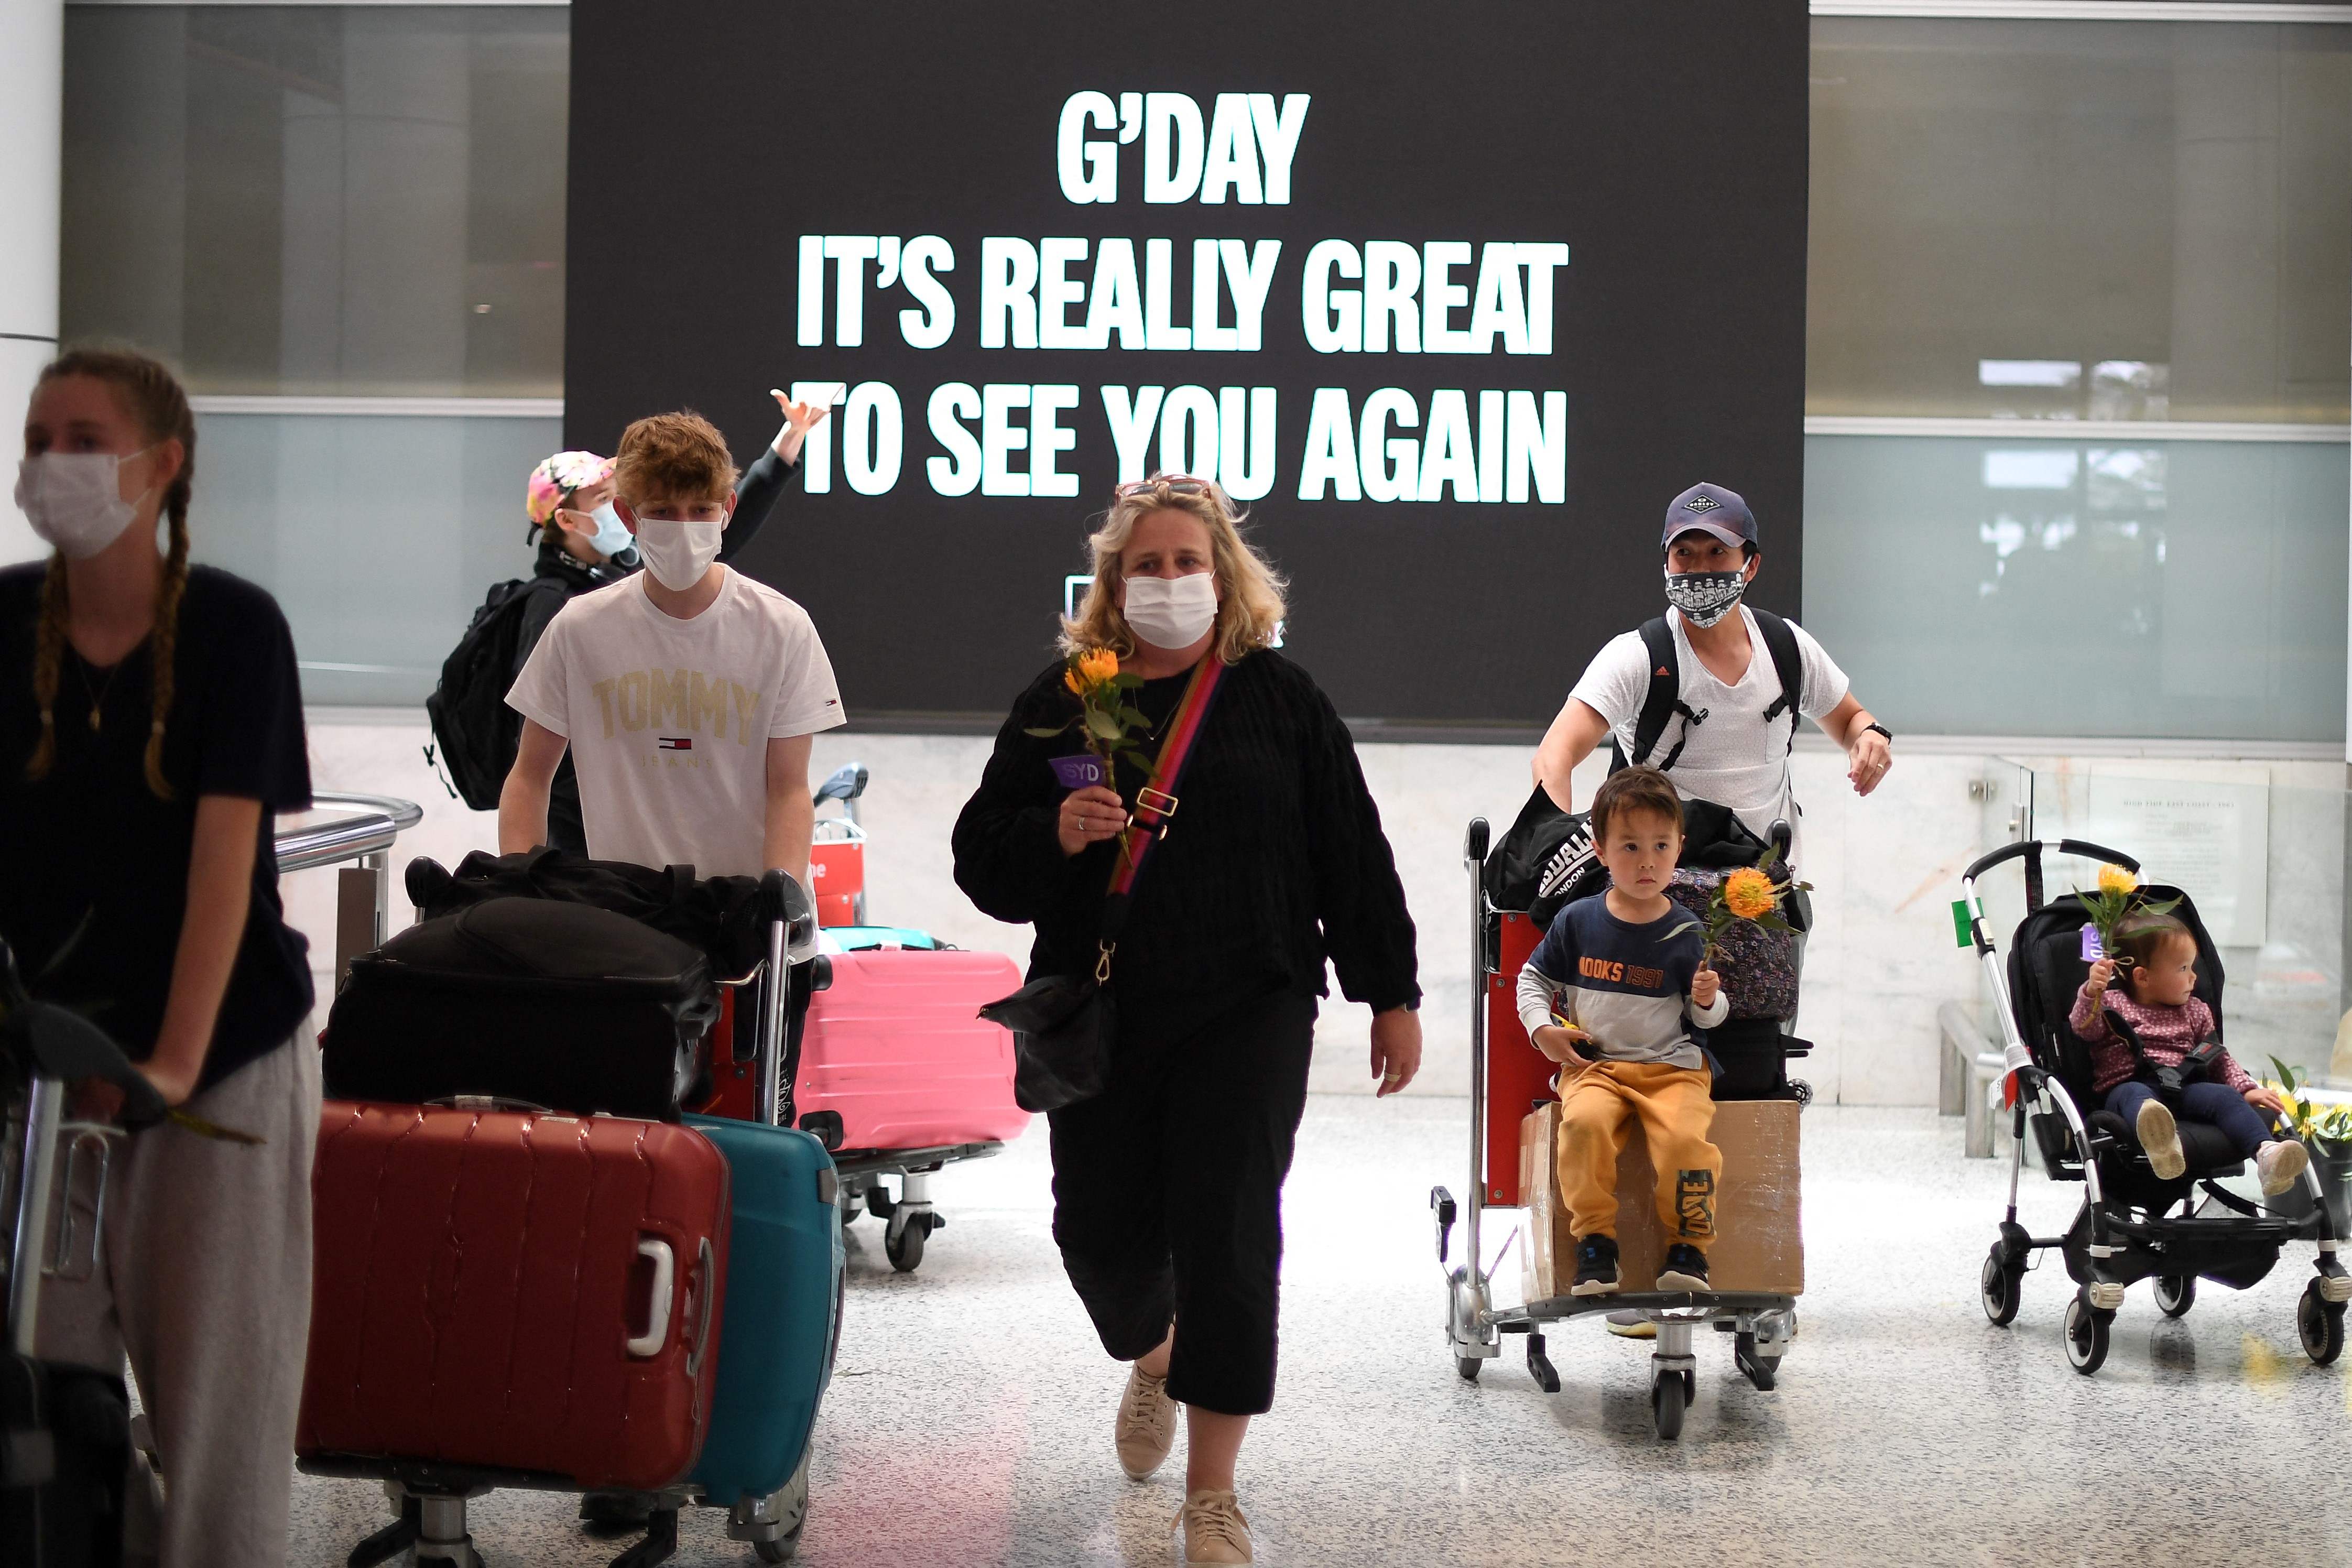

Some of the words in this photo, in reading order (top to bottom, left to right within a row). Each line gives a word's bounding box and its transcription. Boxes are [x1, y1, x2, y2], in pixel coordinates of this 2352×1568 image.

[1057, 90, 1311, 205] G'DAY
[797, 235, 955, 349] IT'S
[981, 236, 1283, 351] REALLY
[1303, 239, 1570, 355] GREAT
[788, 381, 903, 496] TO
[926, 382, 1080, 497] SEE
[1100, 385, 1277, 501] YOU
[1298, 388, 1567, 504] AGAIN
[591, 668, 761, 747] TOMMY
[641, 755, 712, 769] JEANS
[1062, 763, 1099, 781] SYD
[1554, 866, 1586, 897] ONDON
[1626, 965, 1663, 989] 1991
